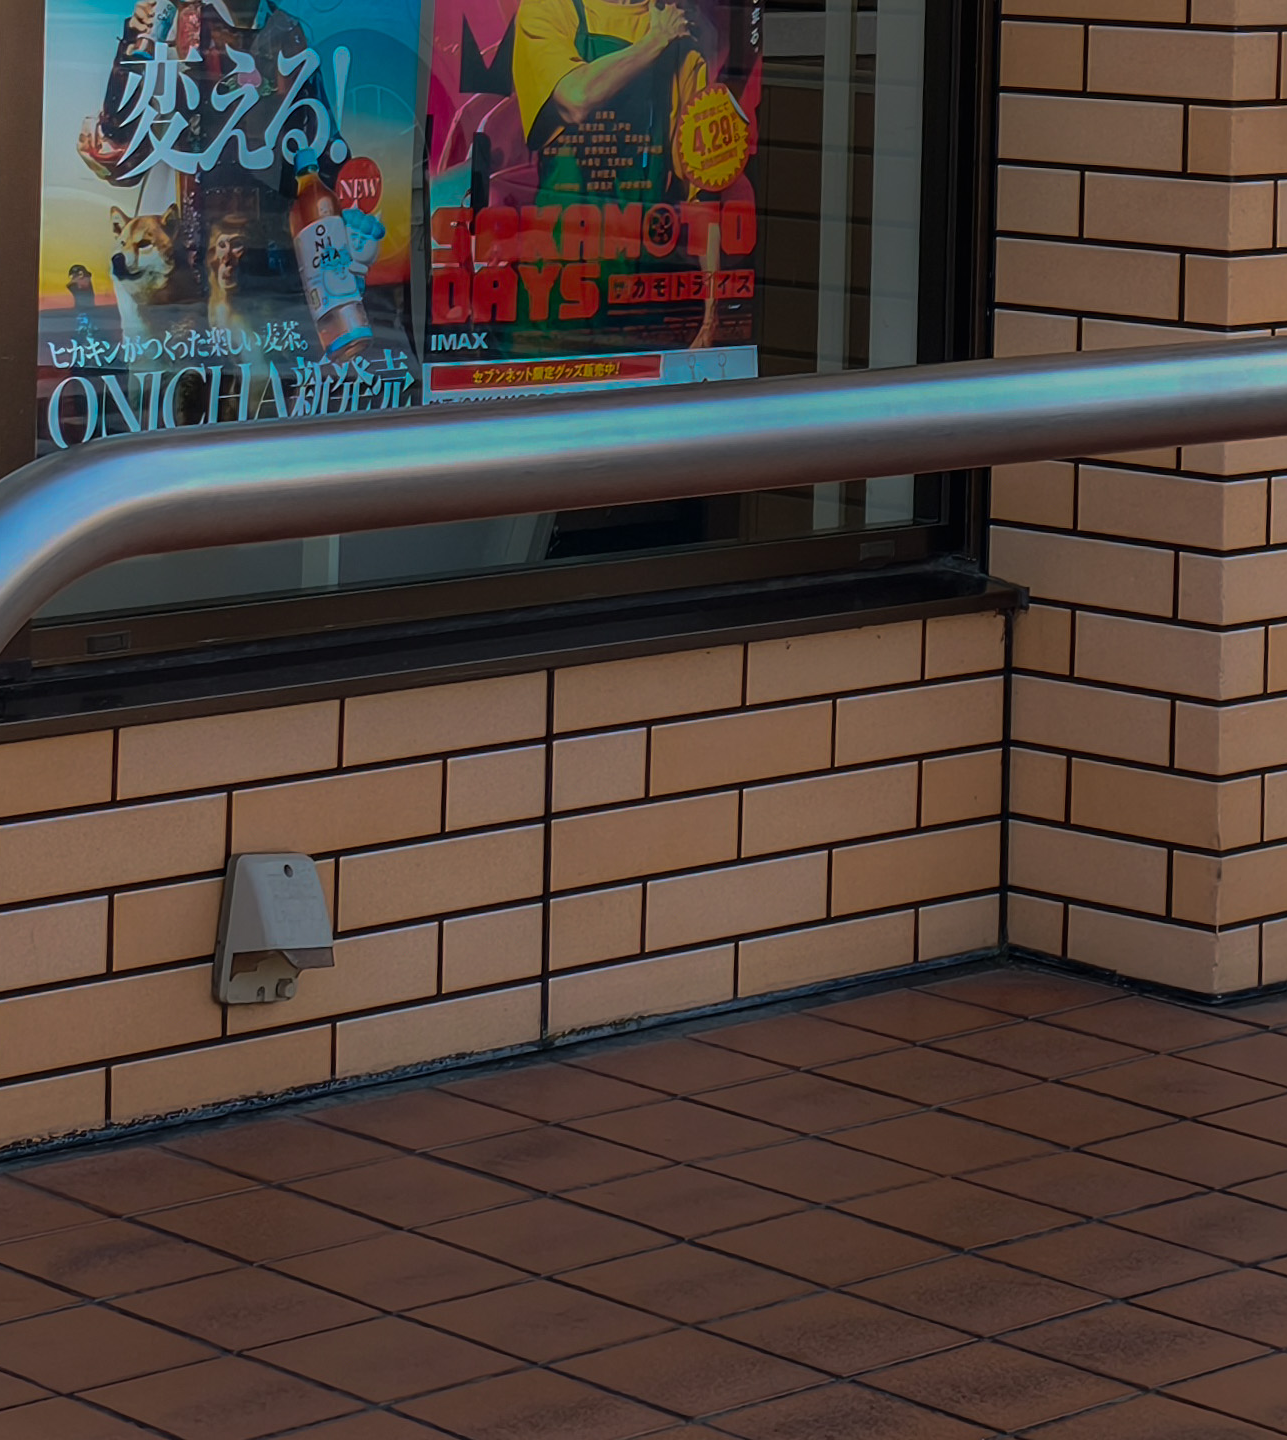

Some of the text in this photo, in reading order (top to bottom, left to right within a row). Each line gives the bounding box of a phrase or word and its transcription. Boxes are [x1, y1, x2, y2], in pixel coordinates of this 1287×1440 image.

[116, 43, 352, 182] 変える!
[339, 177, 381, 200] NEW
[431, 200, 758, 269] SAKAMOTO
[431, 259, 602, 325] DAYS
[431, 331, 489, 351] IMAX
